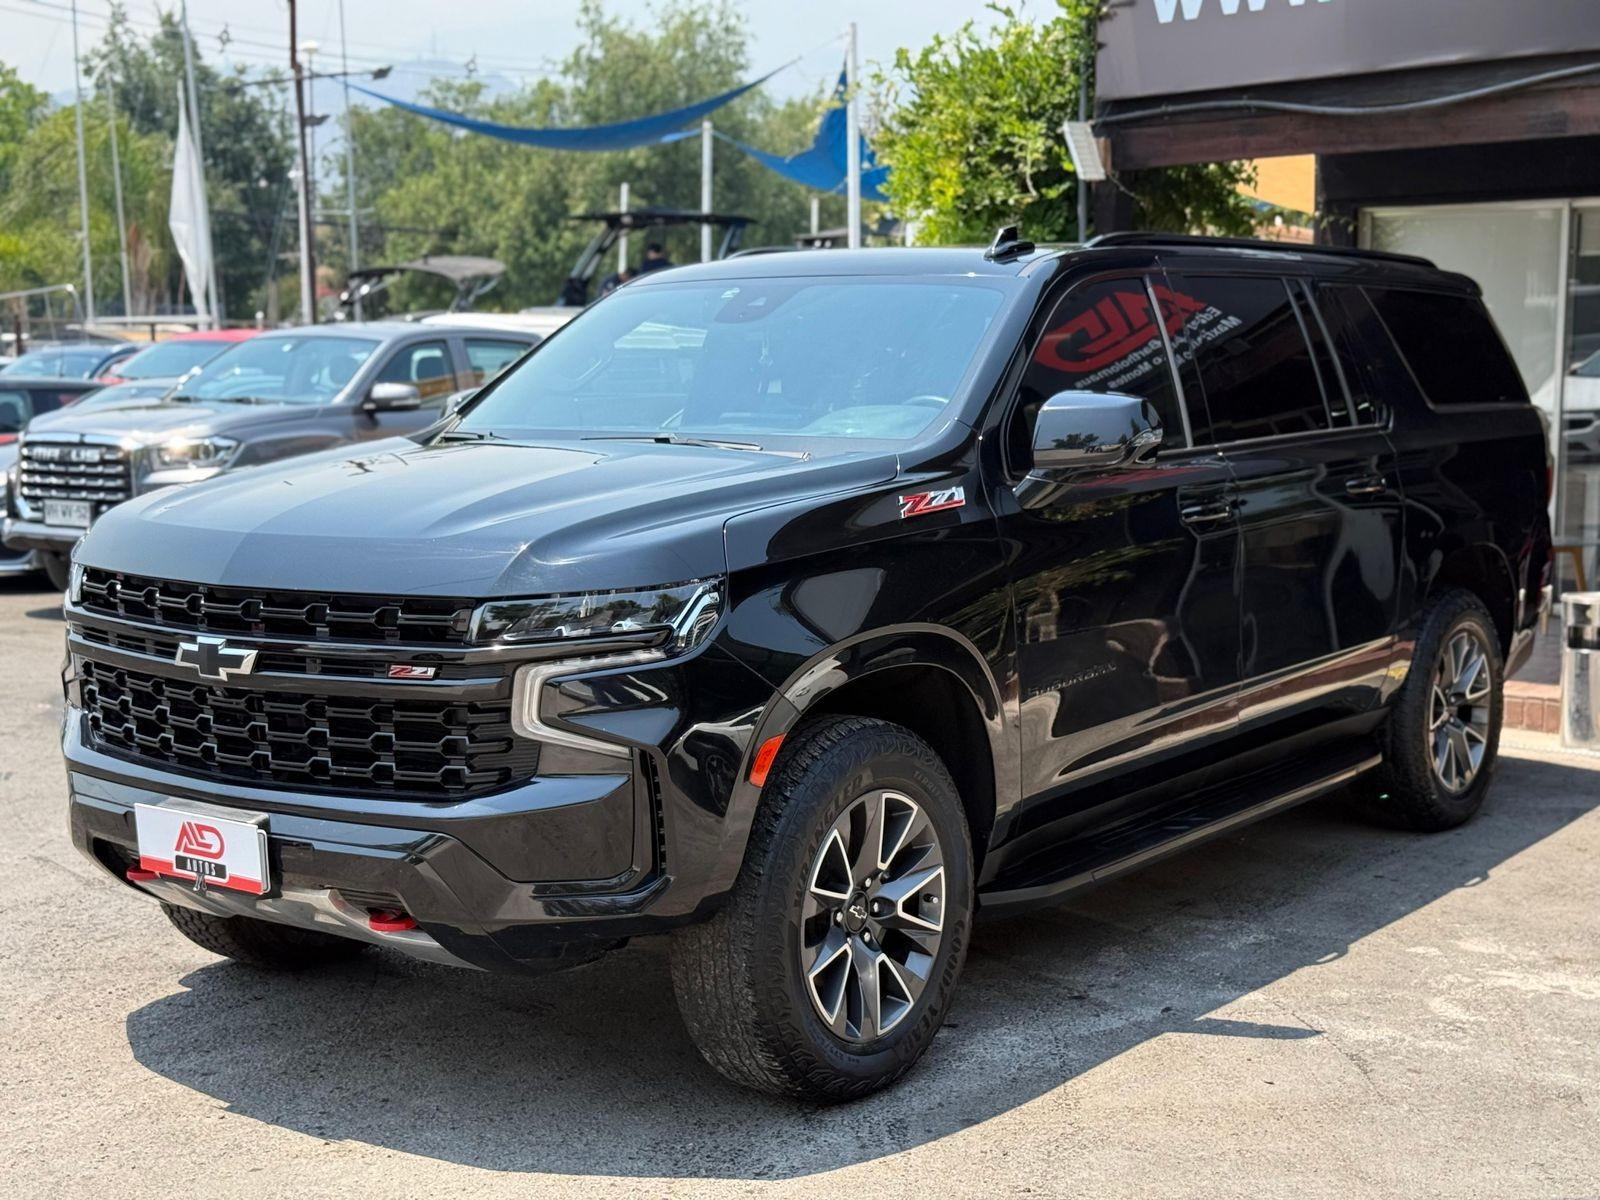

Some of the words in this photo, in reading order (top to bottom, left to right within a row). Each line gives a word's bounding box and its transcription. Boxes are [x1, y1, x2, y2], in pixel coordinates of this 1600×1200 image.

[32, 447, 100, 463] MAUS
[899, 486, 966, 519] Z71
[388, 665, 436, 678] Z71
[187, 858, 216, 876] AUTOS
